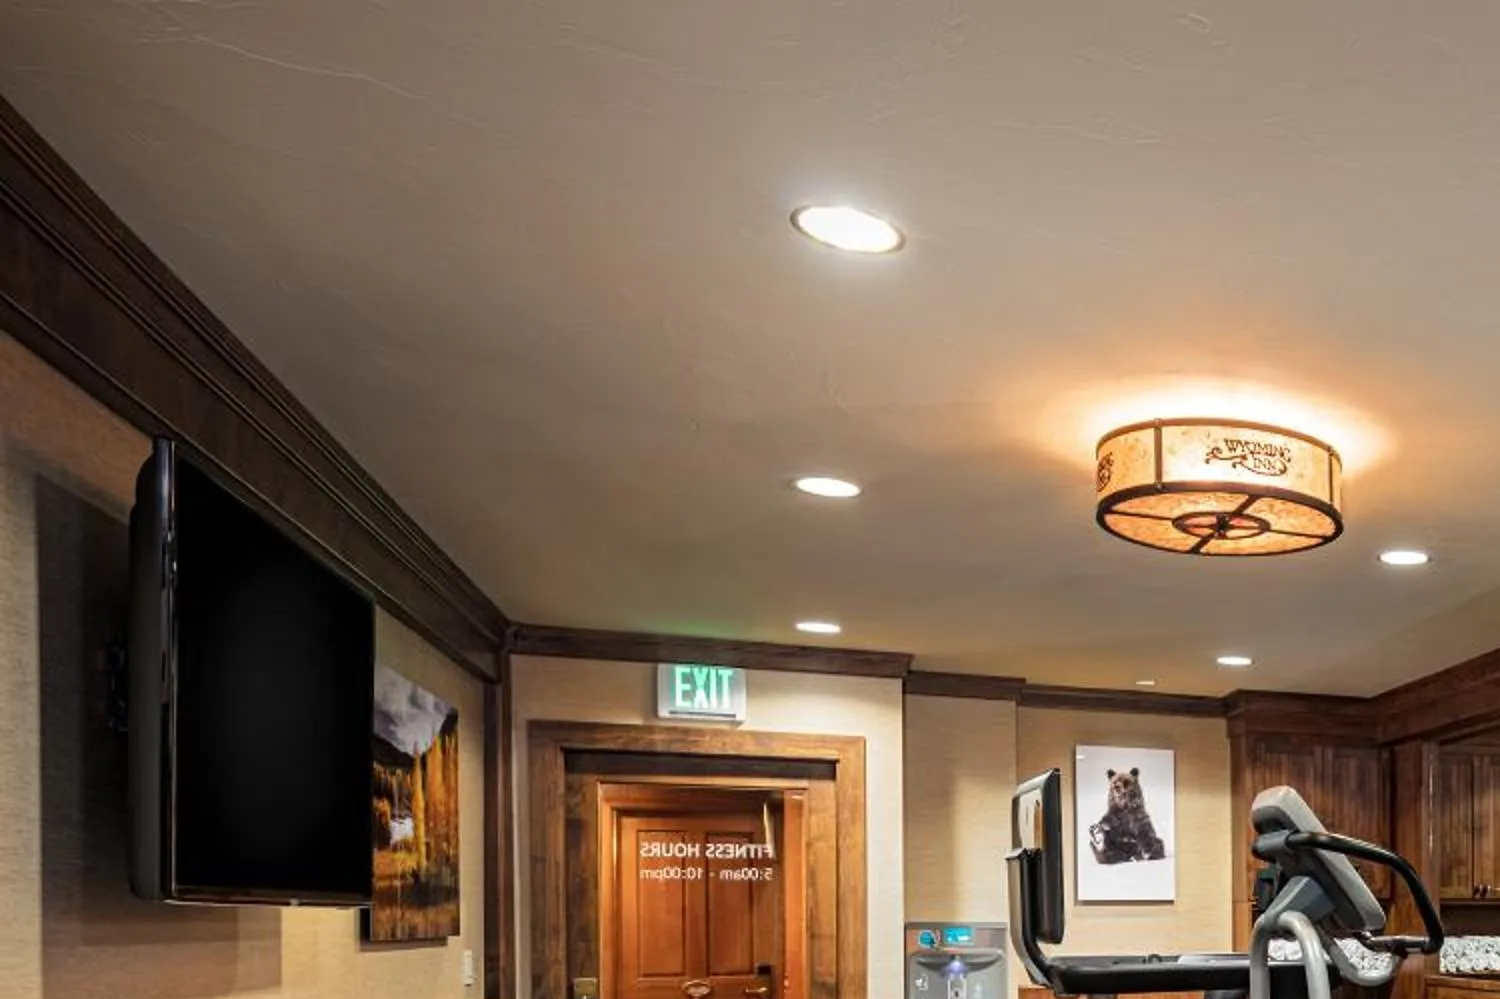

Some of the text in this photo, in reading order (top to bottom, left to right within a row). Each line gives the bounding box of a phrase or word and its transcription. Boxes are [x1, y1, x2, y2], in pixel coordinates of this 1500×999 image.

[1224, 438, 1292, 463] WYOMING
[1252, 457, 1277, 471] INN
[675, 665, 733, 709] EXIT
